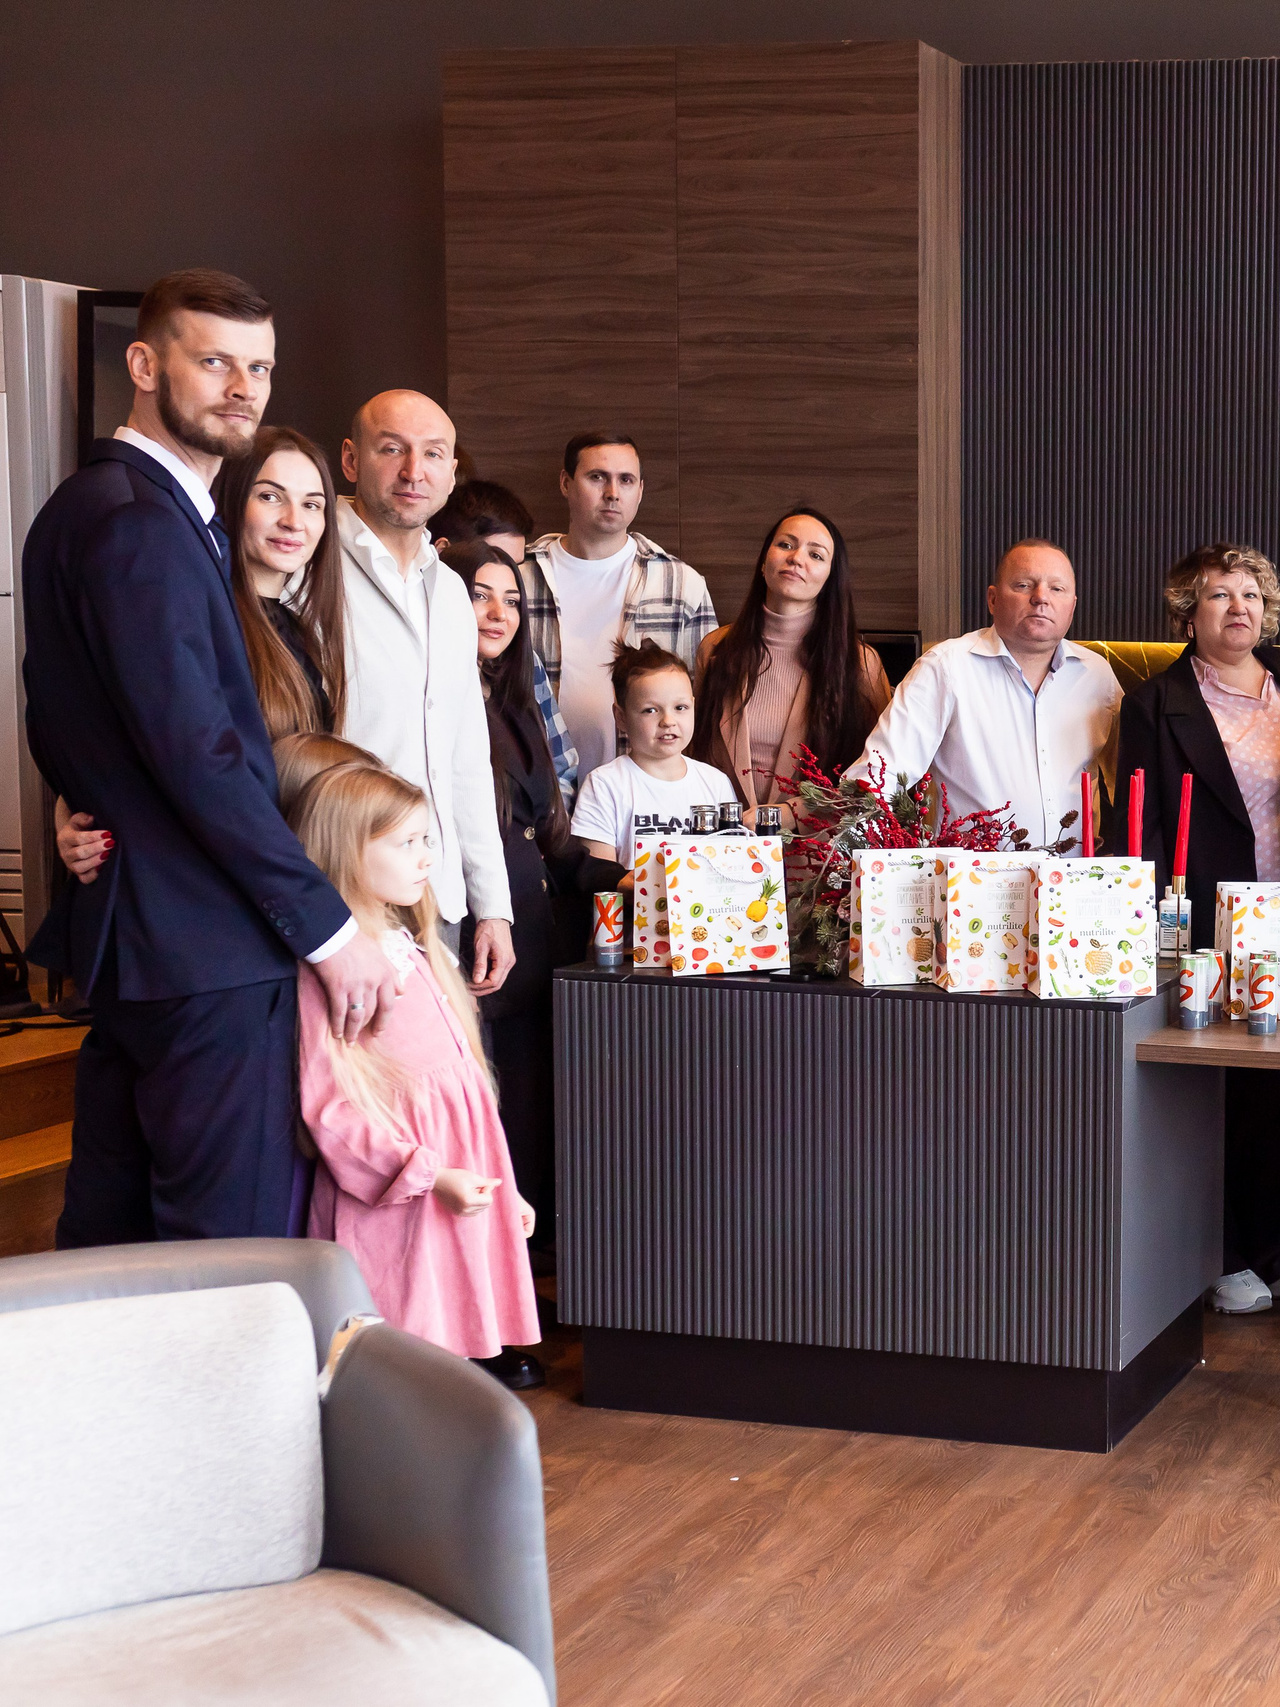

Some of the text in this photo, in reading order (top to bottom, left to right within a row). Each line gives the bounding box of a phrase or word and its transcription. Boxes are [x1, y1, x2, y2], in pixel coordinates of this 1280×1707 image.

[709, 904, 746, 914] nutrilite
[987, 921, 1024, 930] nutrilite
[1079, 927, 1117, 937] nutrilite
